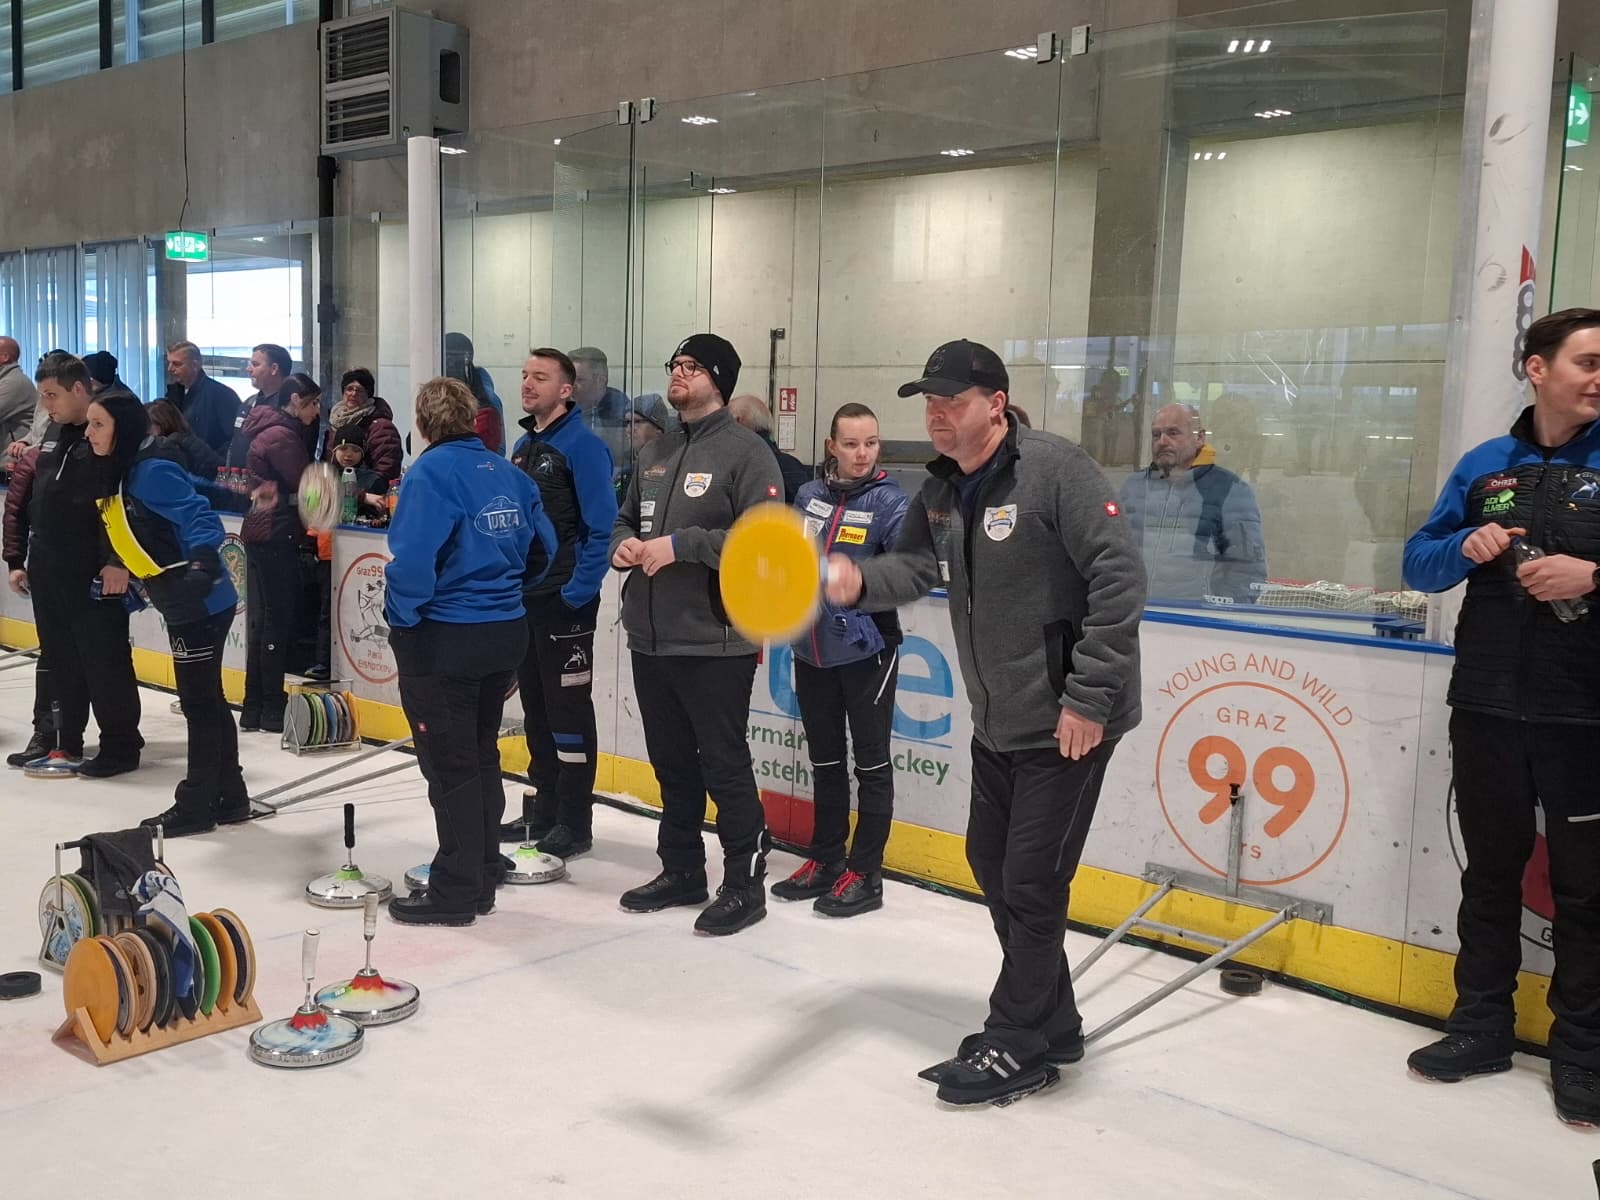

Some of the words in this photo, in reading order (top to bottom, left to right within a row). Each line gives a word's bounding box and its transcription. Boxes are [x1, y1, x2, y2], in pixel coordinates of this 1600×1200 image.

[482, 509, 519, 531] TURZA
[1158, 653, 1236, 699] YOUNG
[1244, 653, 1296, 681] AND
[1302, 671, 1353, 728] WILD
[1217, 706, 1287, 733] GRAZ
[1187, 735, 1316, 839] 99
[1240, 841, 1262, 860] rs
